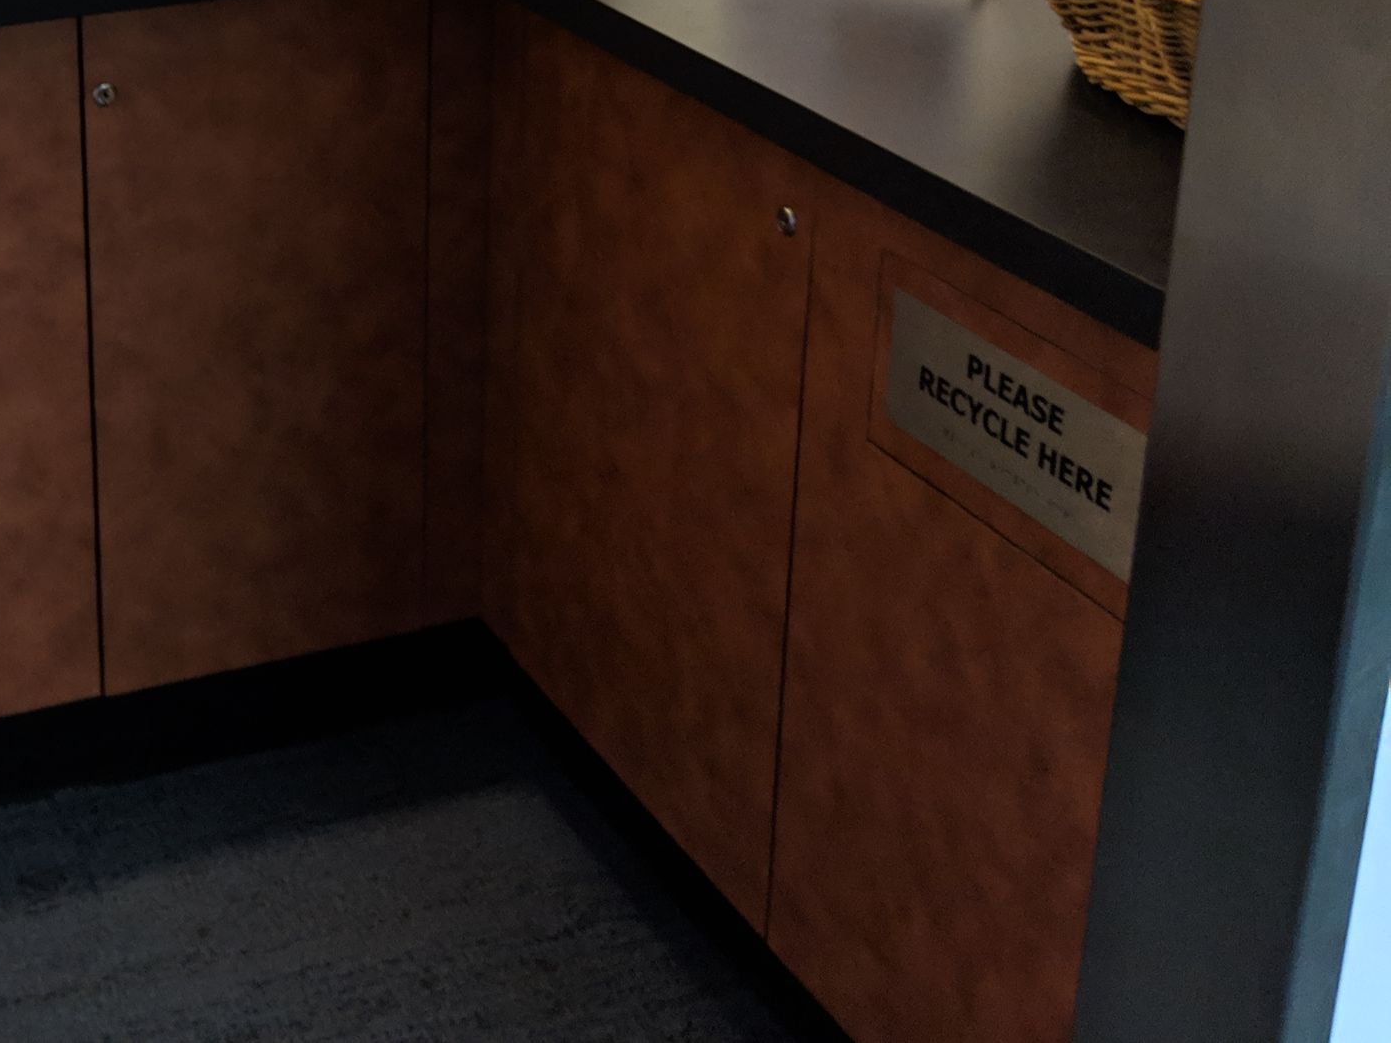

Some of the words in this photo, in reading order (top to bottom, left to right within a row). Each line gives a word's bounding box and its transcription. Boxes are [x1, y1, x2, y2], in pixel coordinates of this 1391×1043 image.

[918, 364, 1031, 459] RECYCLE
[1037, 440, 1114, 514] HERE
[967, 353, 1067, 436] PLEASE
